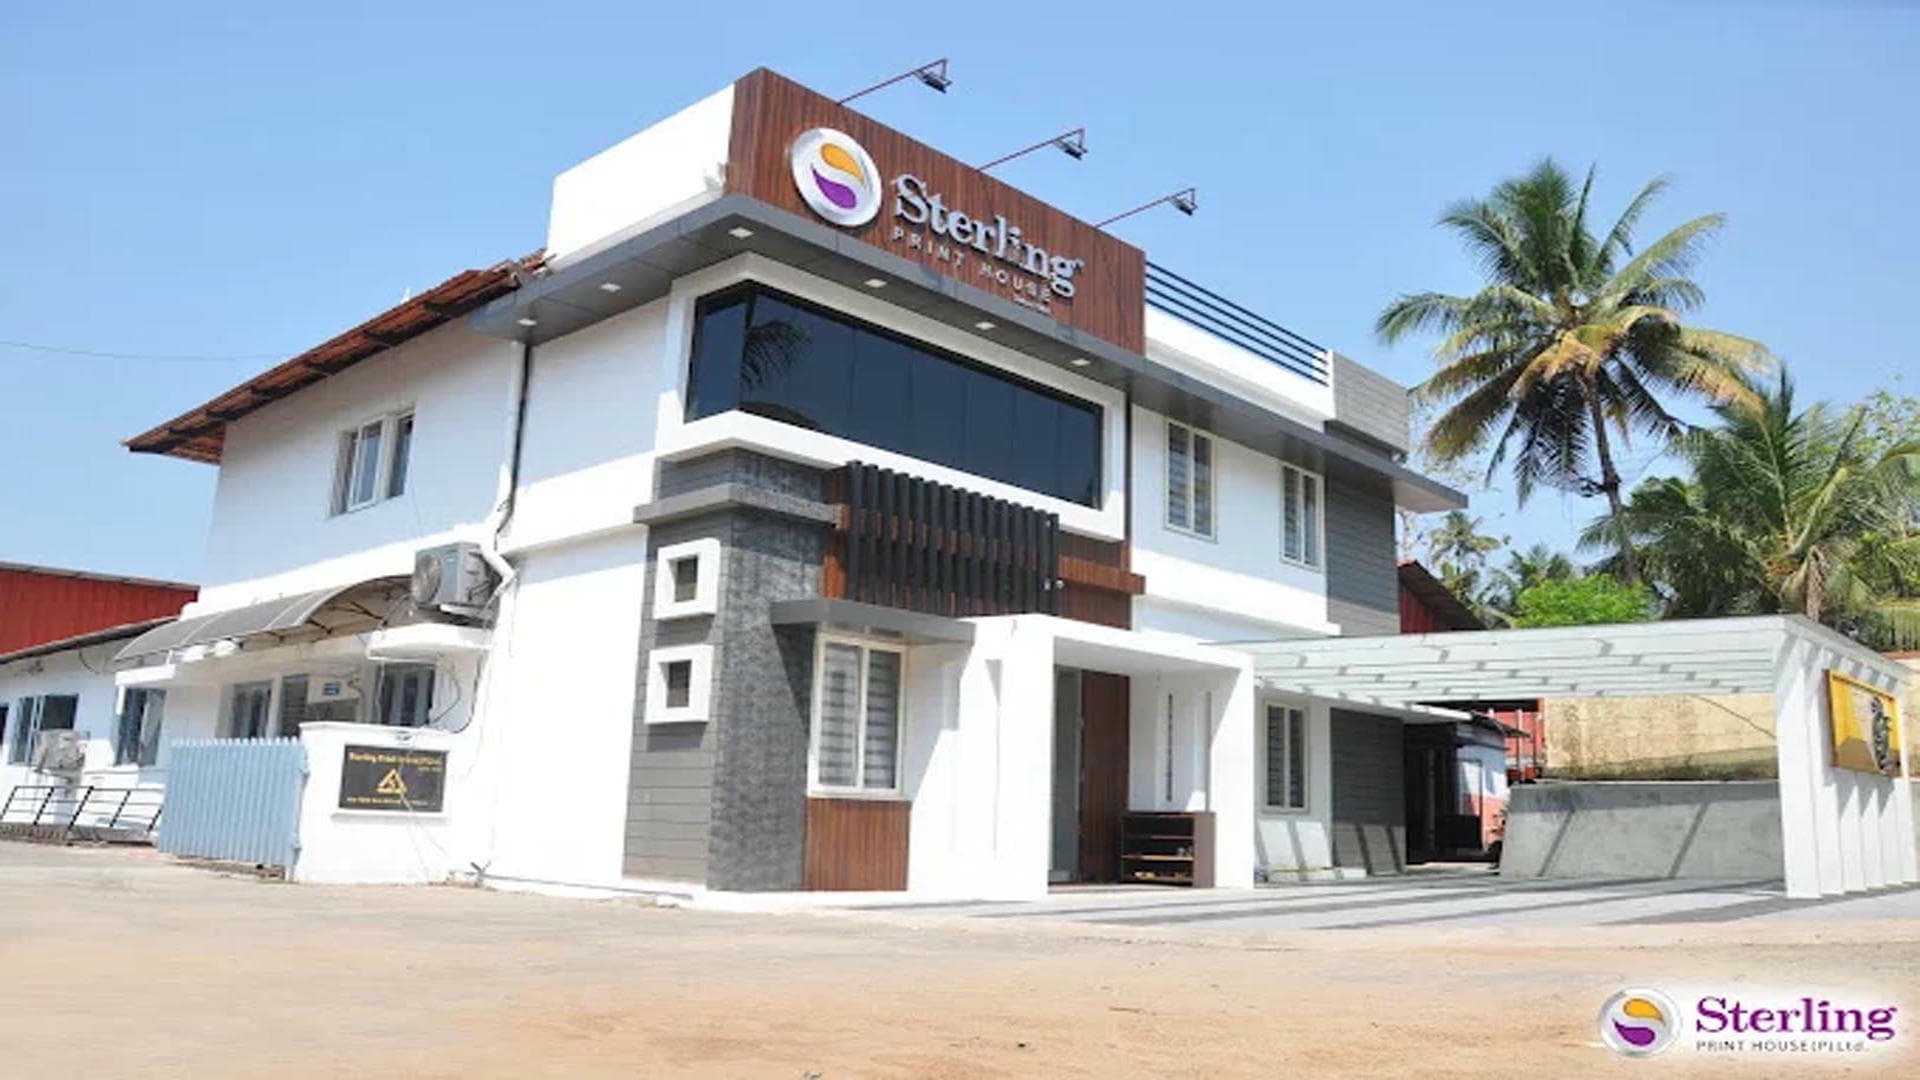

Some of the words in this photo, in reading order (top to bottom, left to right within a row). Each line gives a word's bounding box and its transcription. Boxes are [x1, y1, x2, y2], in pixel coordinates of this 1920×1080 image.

[892, 173, 1084, 298] Sterling
[892, 225, 965, 268] PRINT
[979, 261, 1052, 303] HOUSE
